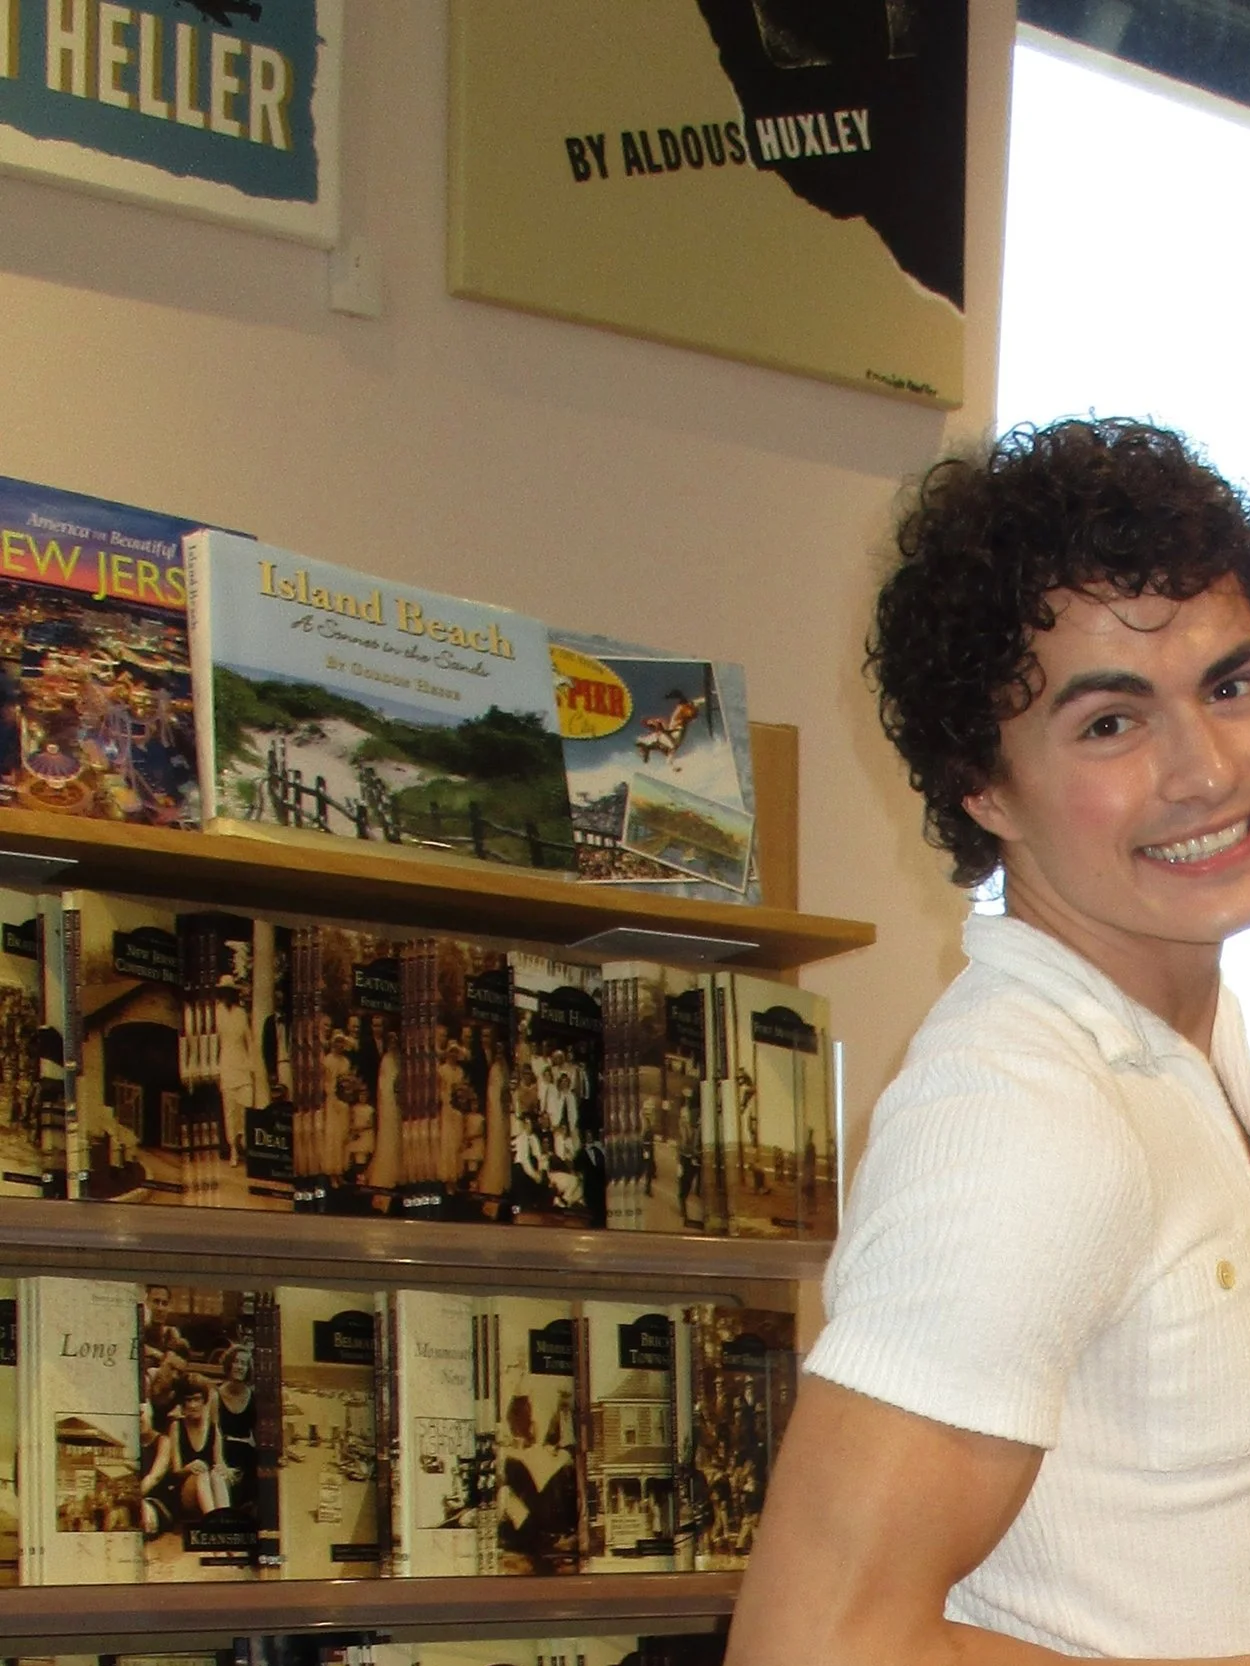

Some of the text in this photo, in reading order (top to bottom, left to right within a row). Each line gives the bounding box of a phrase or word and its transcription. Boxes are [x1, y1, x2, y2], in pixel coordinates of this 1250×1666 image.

[45, 0, 292, 151] HELLER
[565, 108, 871, 184] BY ALDOUS HUXLEY
[0, 529, 81, 580] EW
[258, 560, 386, 626] Island
[395, 597, 515, 661] Beach
[58, 1330, 118, 1368] Long
